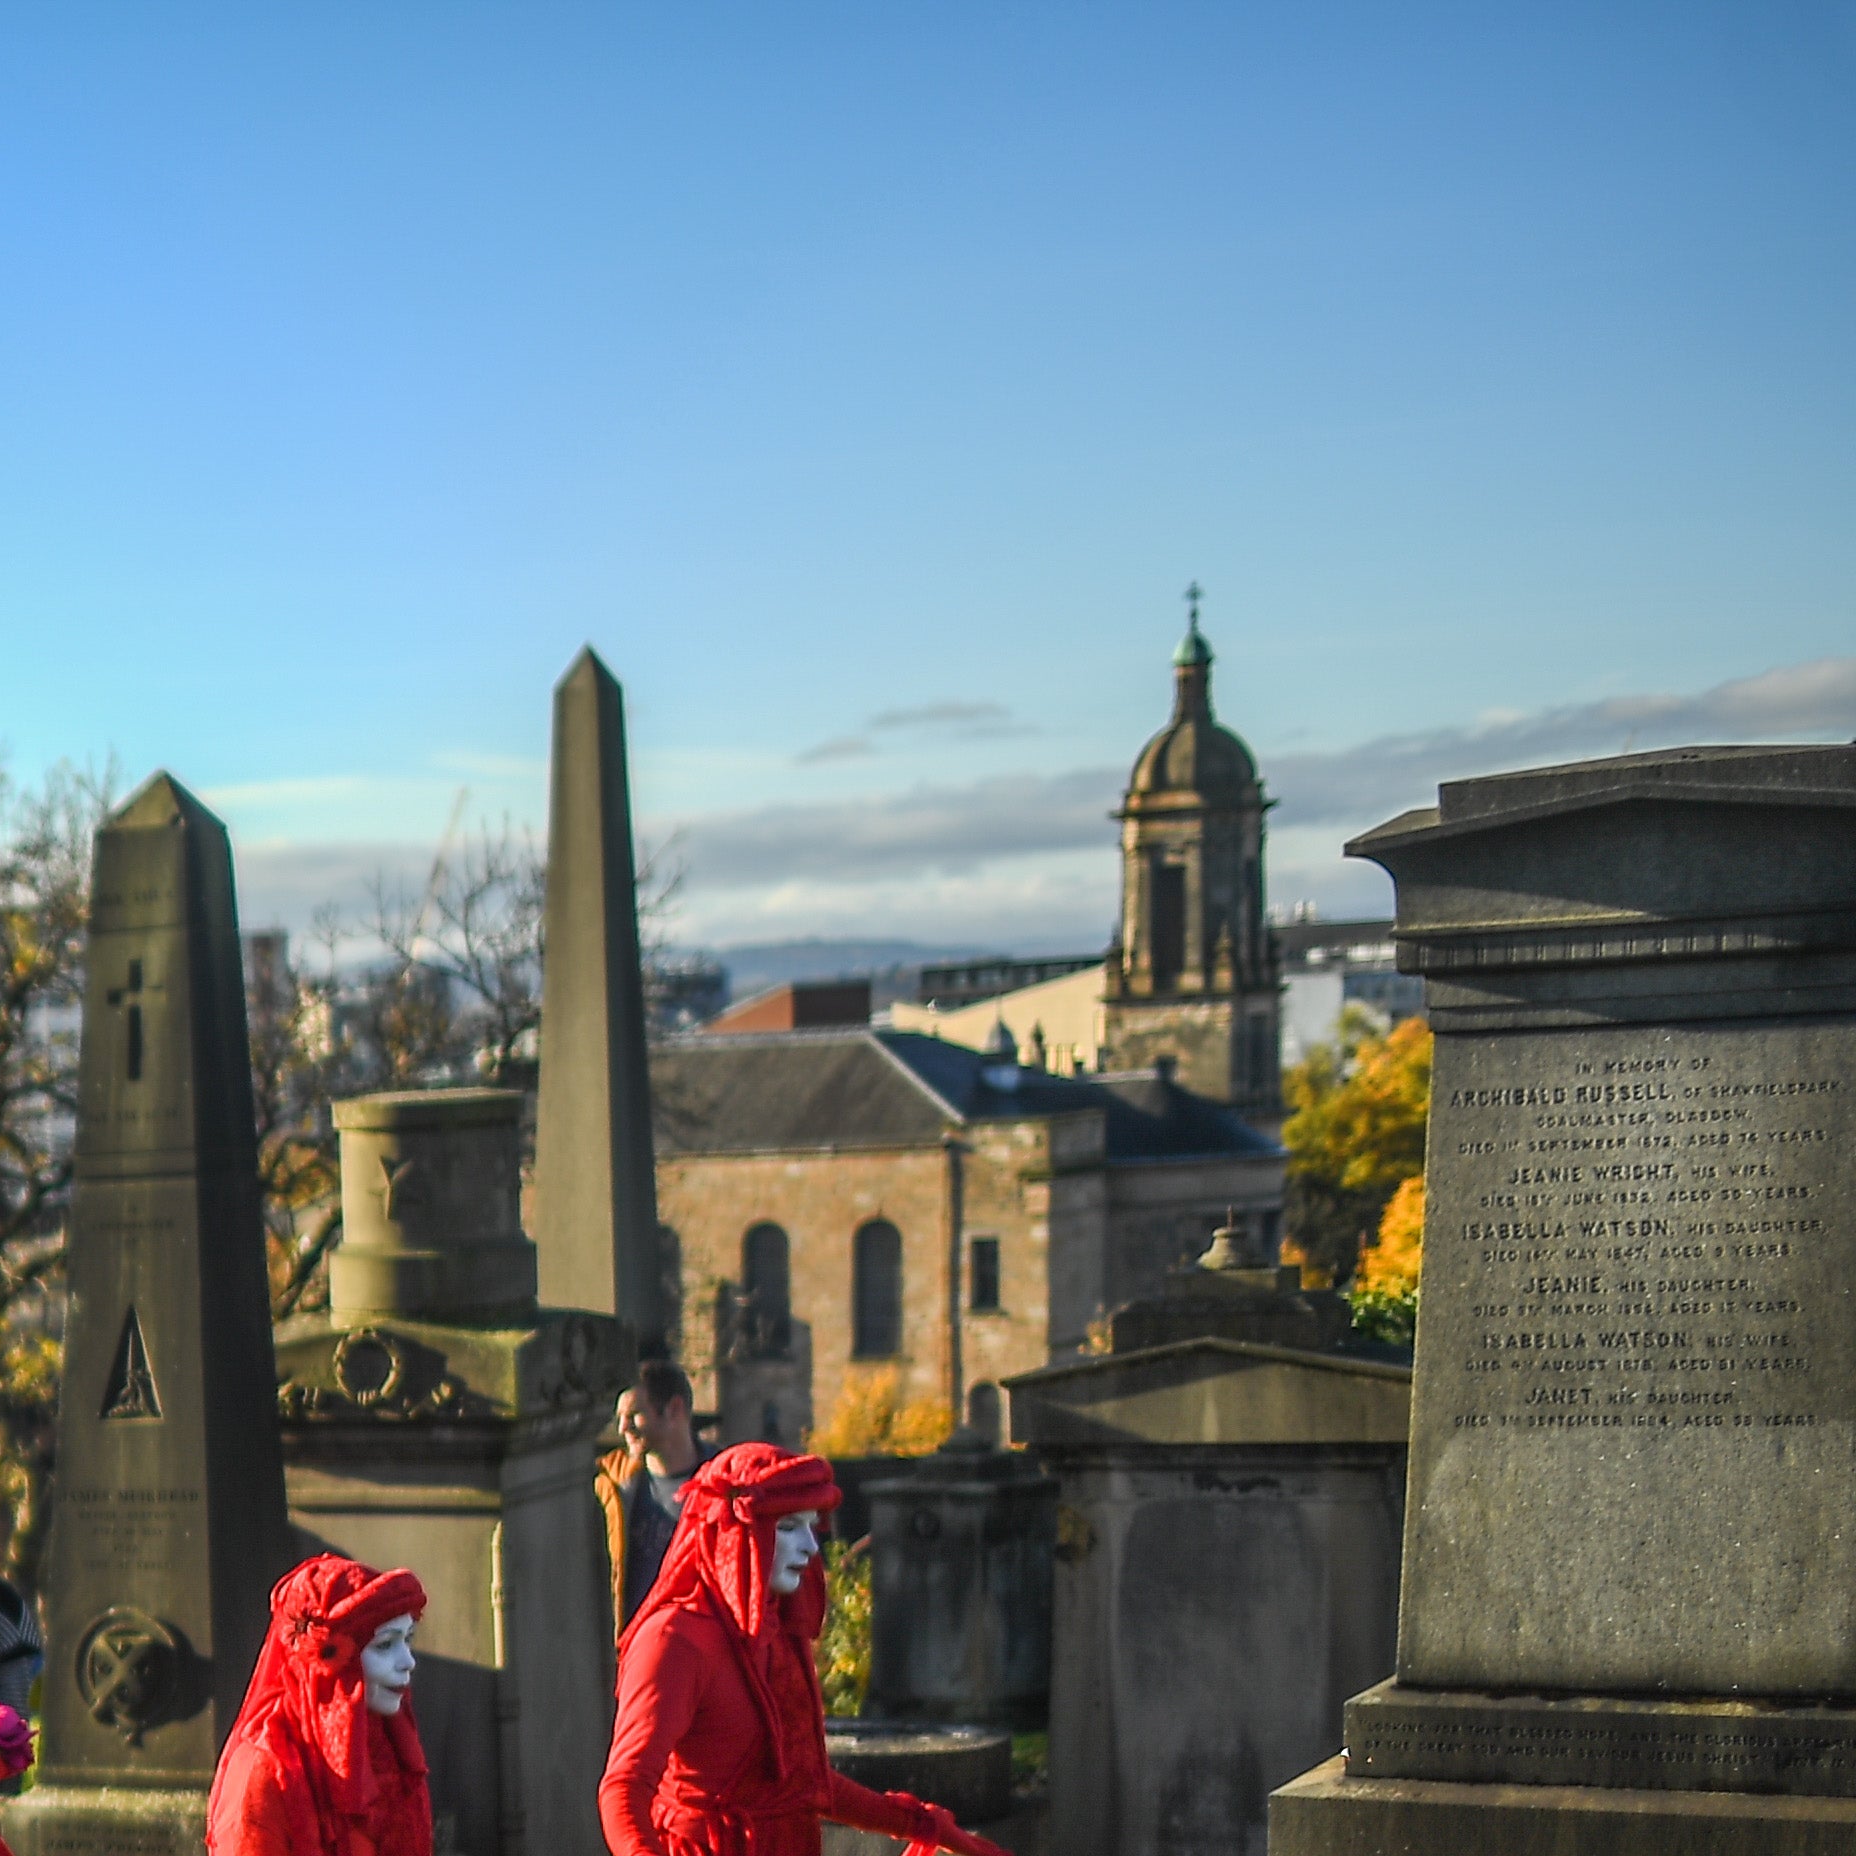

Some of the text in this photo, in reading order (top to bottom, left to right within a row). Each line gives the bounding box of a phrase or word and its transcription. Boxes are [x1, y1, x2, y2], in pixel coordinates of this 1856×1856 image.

[1575, 1056, 1712, 1075] IN MEMORY OF
[1451, 1086, 1565, 1108] ARCHIBALD
[1575, 1083, 1677, 1103] RUSSELL,
[1528, 1137, 1627, 1153] SEPTEMBER
[1688, 1132, 1730, 1148] AGED
[1508, 1166, 1582, 1185] JEANIE
[1593, 1163, 1680, 1183] WRIGHT,
[1691, 1165, 1717, 1178] HIS
[1563, 1191, 1604, 1206] JUNE
[1666, 1190, 1711, 1202] AGED
[1462, 1222, 1566, 1241] ISABELLA
[1688, 1222, 1717, 1235] HIS
[1565, 1247, 1598, 1261] MAY
[1659, 1245, 1703, 1259] AGED
[1618, 1279, 1647, 1293] HIS
[1551, 1304, 1608, 1316] MARCH
[1669, 1301, 1711, 1314] AGED
[1483, 1333, 1587, 1350] ISABELLA
[1541, 1358, 1609, 1372] AUGUST
[1668, 1358, 1711, 1371] AGED
[1527, 1414, 1623, 1428] SEPTEMBER
